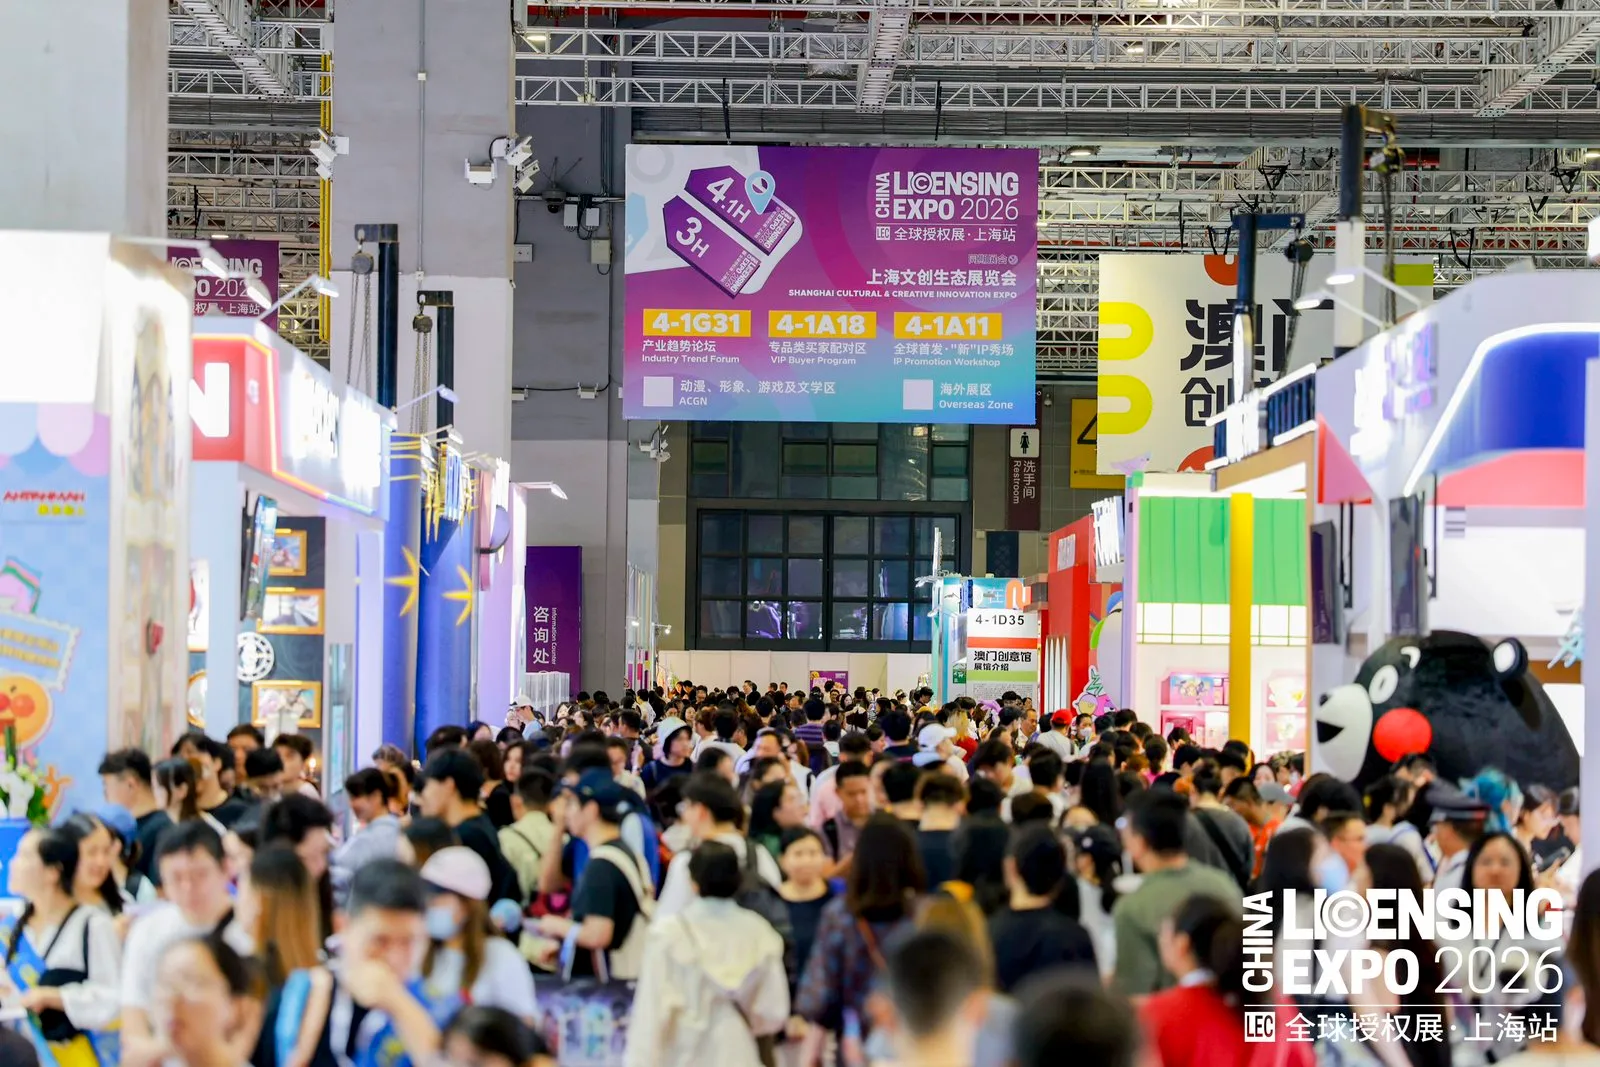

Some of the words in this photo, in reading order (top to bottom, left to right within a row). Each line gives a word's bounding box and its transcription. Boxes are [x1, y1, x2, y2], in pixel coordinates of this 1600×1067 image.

[875, 172, 890, 218] CHINA
[893, 198, 955, 220] EXPO
[960, 198, 1019, 220] 2026
[866, 268, 1017, 286] 上海文创生态展览会
[788, 289, 835, 297] SHANGHAI
[892, 290, 935, 298] CREATIVE
[936, 291, 992, 299] INNOVATION
[993, 291, 1017, 299] EXPO
[652, 312, 740, 333] 4-1G31
[776, 314, 866, 335] 4-1A18
[905, 315, 989, 336] 4-1A11
[642, 339, 717, 352] 产业趋势论坛
[769, 341, 867, 354] 专品类买家配对区
[642, 354, 679, 364] Industry
[681, 355, 709, 363] Trend
[710, 355, 740, 363] Forum
[771, 356, 786, 364] VIP
[788, 356, 815, 366] Buyer
[816, 356, 857, 366] Program
[904, 358, 952, 366] Promotion
[954, 358, 1001, 367] Workshop
[680, 379, 836, 394] 动漫、形象、游戏及文学区
[940, 383, 992, 396] 海外展区
[679, 396, 708, 406] ACGN
[939, 400, 985, 409] Overseas
[987, 400, 1014, 409] Zone
[1013, 460, 1022, 504] Restroom
[1023, 460, 1036, 499] 洗手间
[533, 606, 549, 664] 咨询处
[973, 650, 1032, 662] 澳门创意馆
[974, 663, 1009, 671] 展馆介绍
